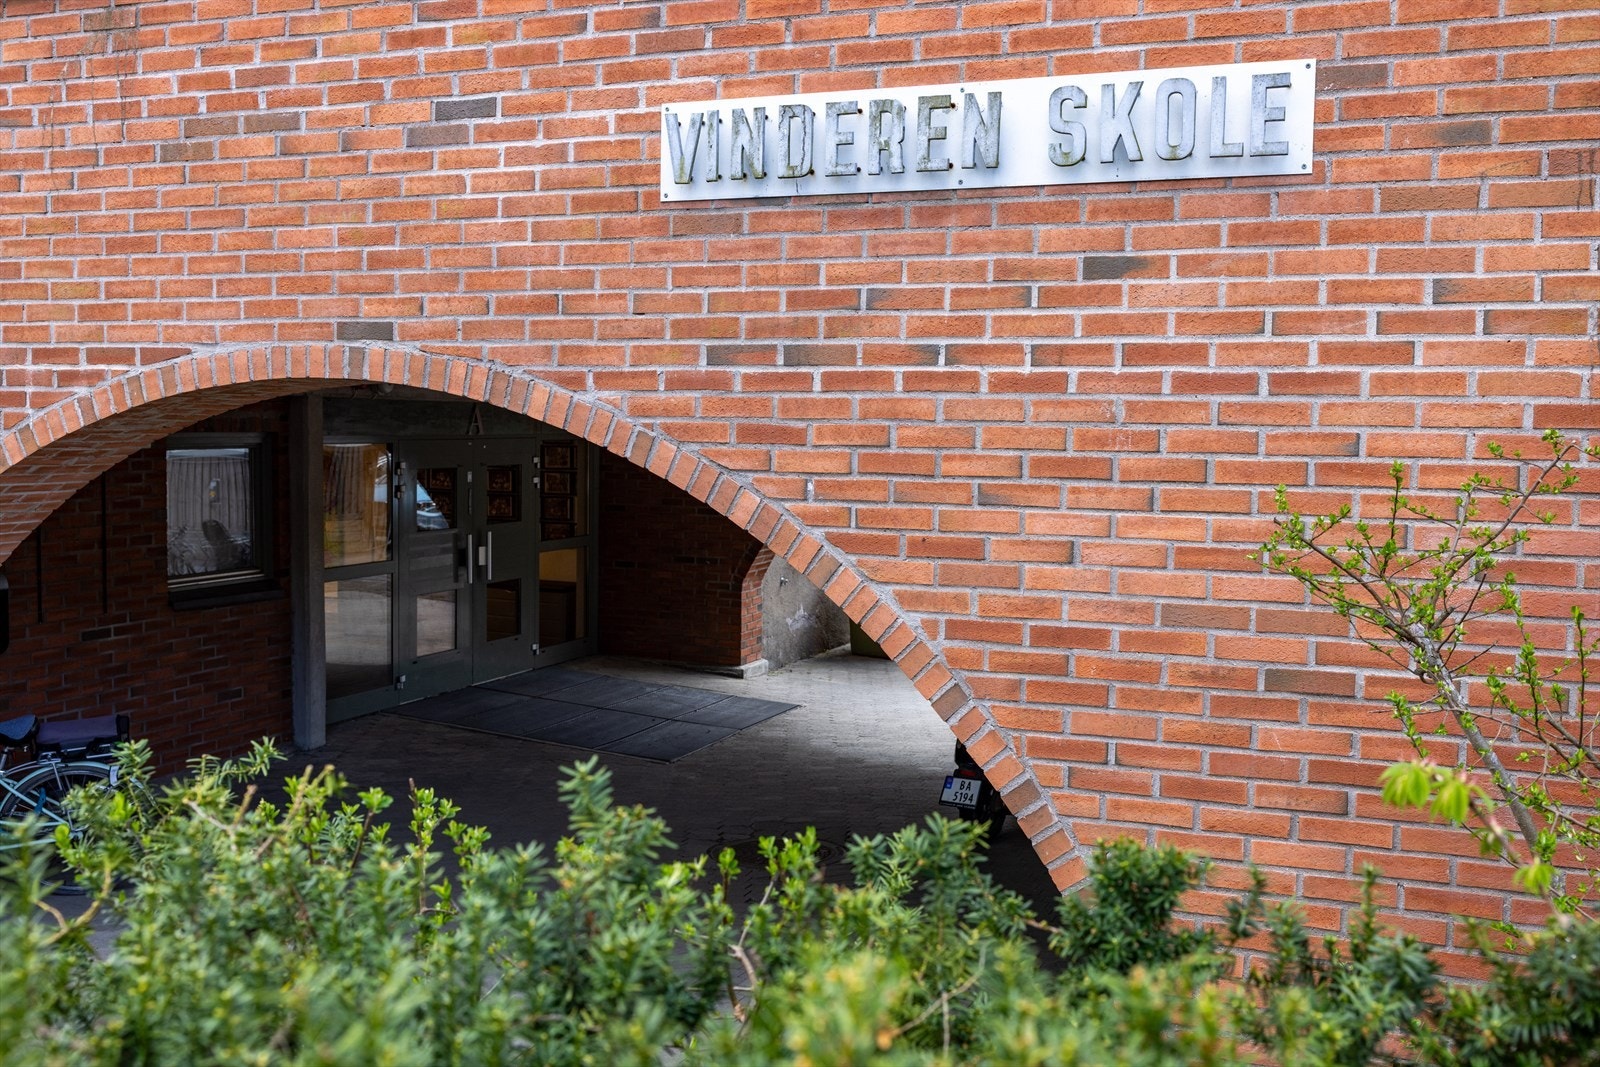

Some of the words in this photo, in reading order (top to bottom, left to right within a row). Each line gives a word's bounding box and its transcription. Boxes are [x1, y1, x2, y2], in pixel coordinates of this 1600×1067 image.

[665, 91, 1002, 184] VINDEREN
[1048, 72, 1291, 167] SKOLE
[467, 402, 485, 435] A
[959, 780, 972, 791] BA
[952, 791, 974, 804] 5194
